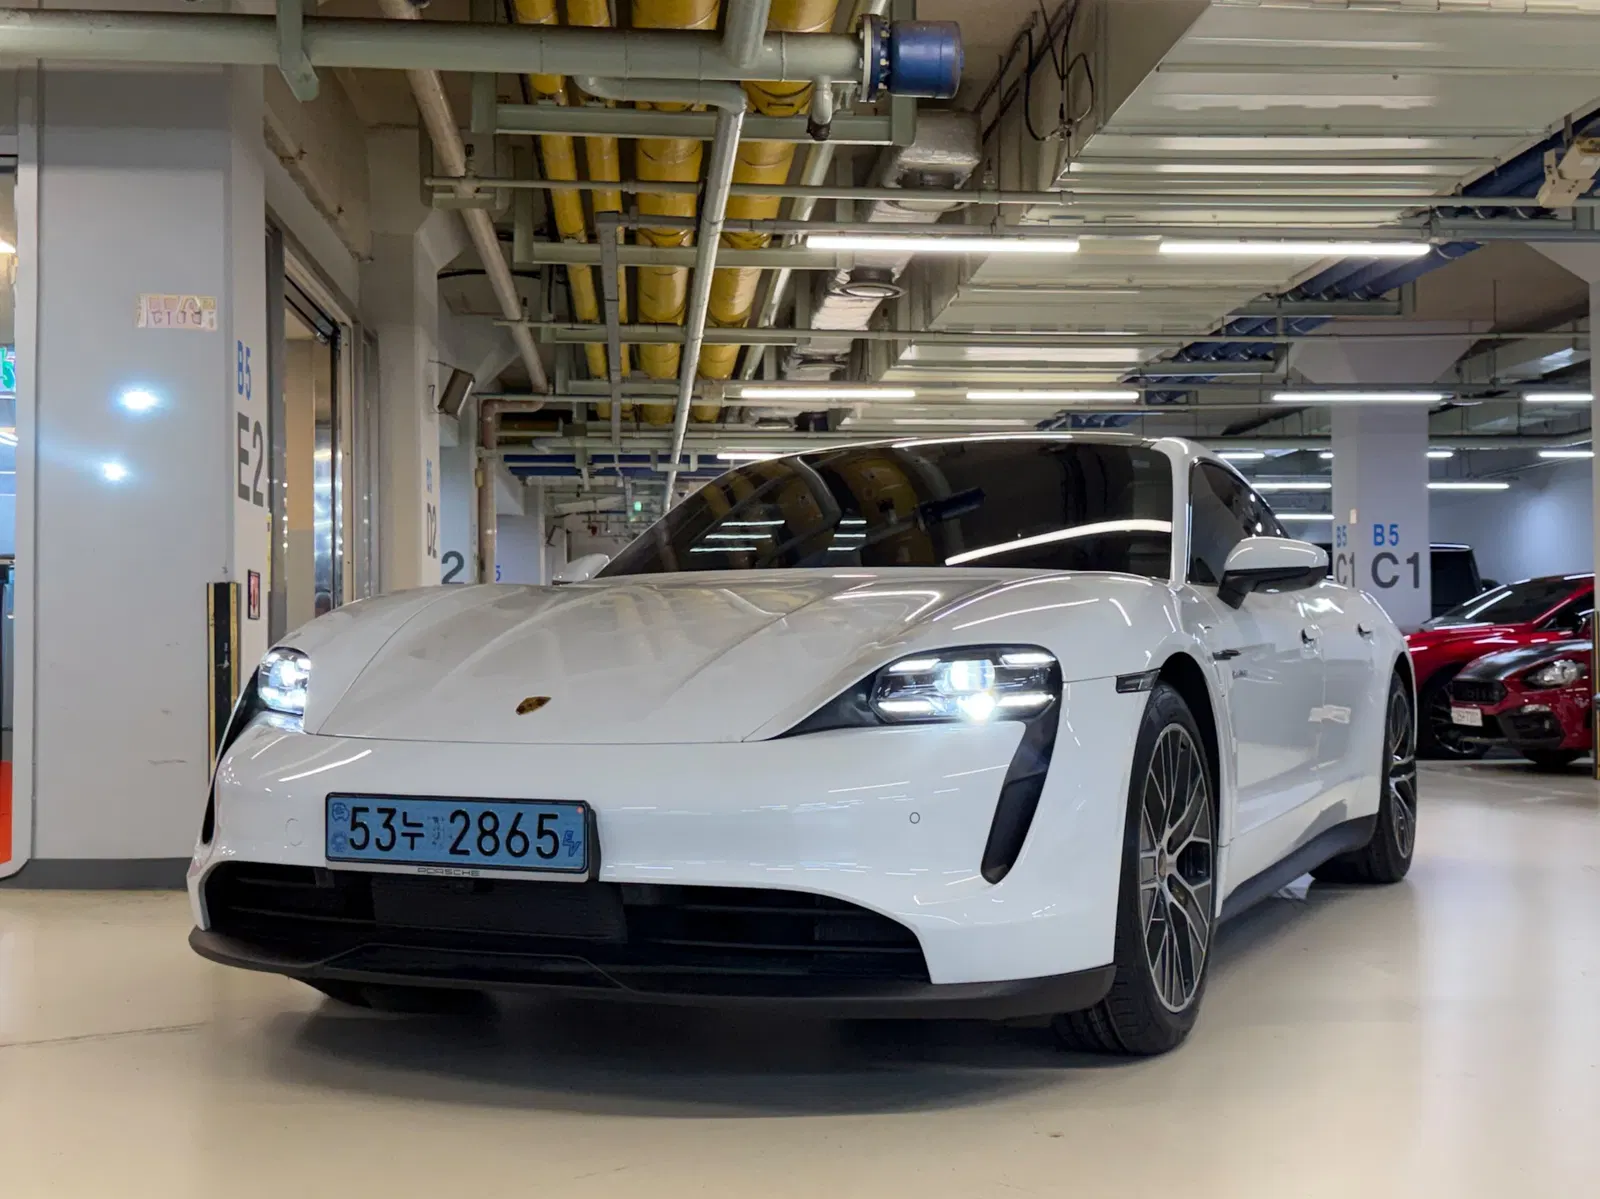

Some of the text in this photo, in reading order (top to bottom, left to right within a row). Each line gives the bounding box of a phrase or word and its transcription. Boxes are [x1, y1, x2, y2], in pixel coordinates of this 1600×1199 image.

[237, 340, 251, 401] B5
[237, 411, 264, 508] E2
[1373, 524, 1400, 547] B5
[1335, 552, 1356, 588] C1
[1371, 552, 1420, 589] C1
[349, 806, 560, 859] 53누 2865
[417, 867, 480, 877] PORSCHE
